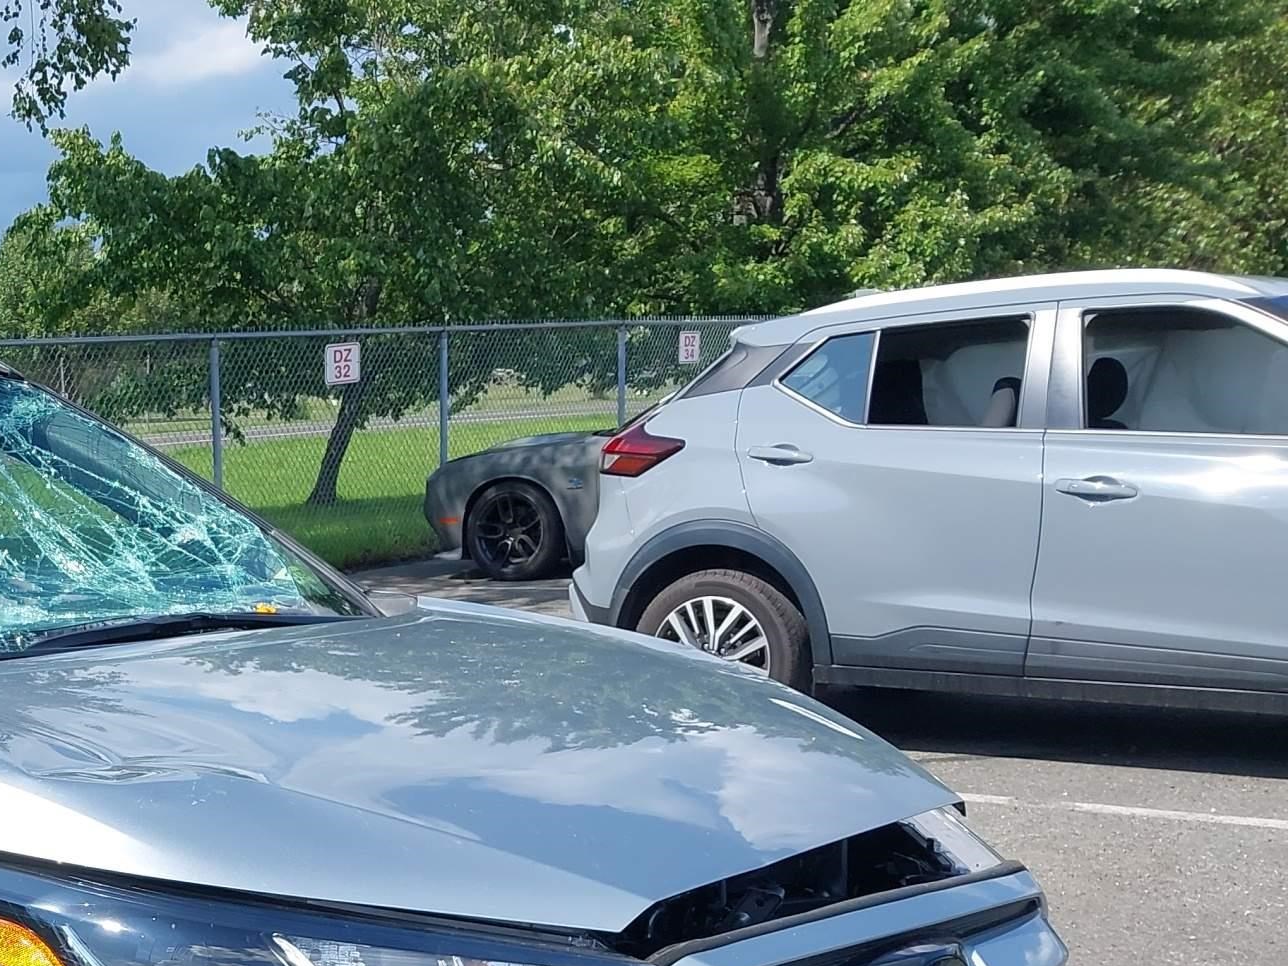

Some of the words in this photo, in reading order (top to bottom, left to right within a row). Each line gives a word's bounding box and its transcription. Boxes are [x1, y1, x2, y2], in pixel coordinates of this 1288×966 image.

[684, 335, 696, 348] DZ
[333, 348, 352, 363] DZ
[684, 348, 695, 360] 34
[334, 363, 351, 379] 32
